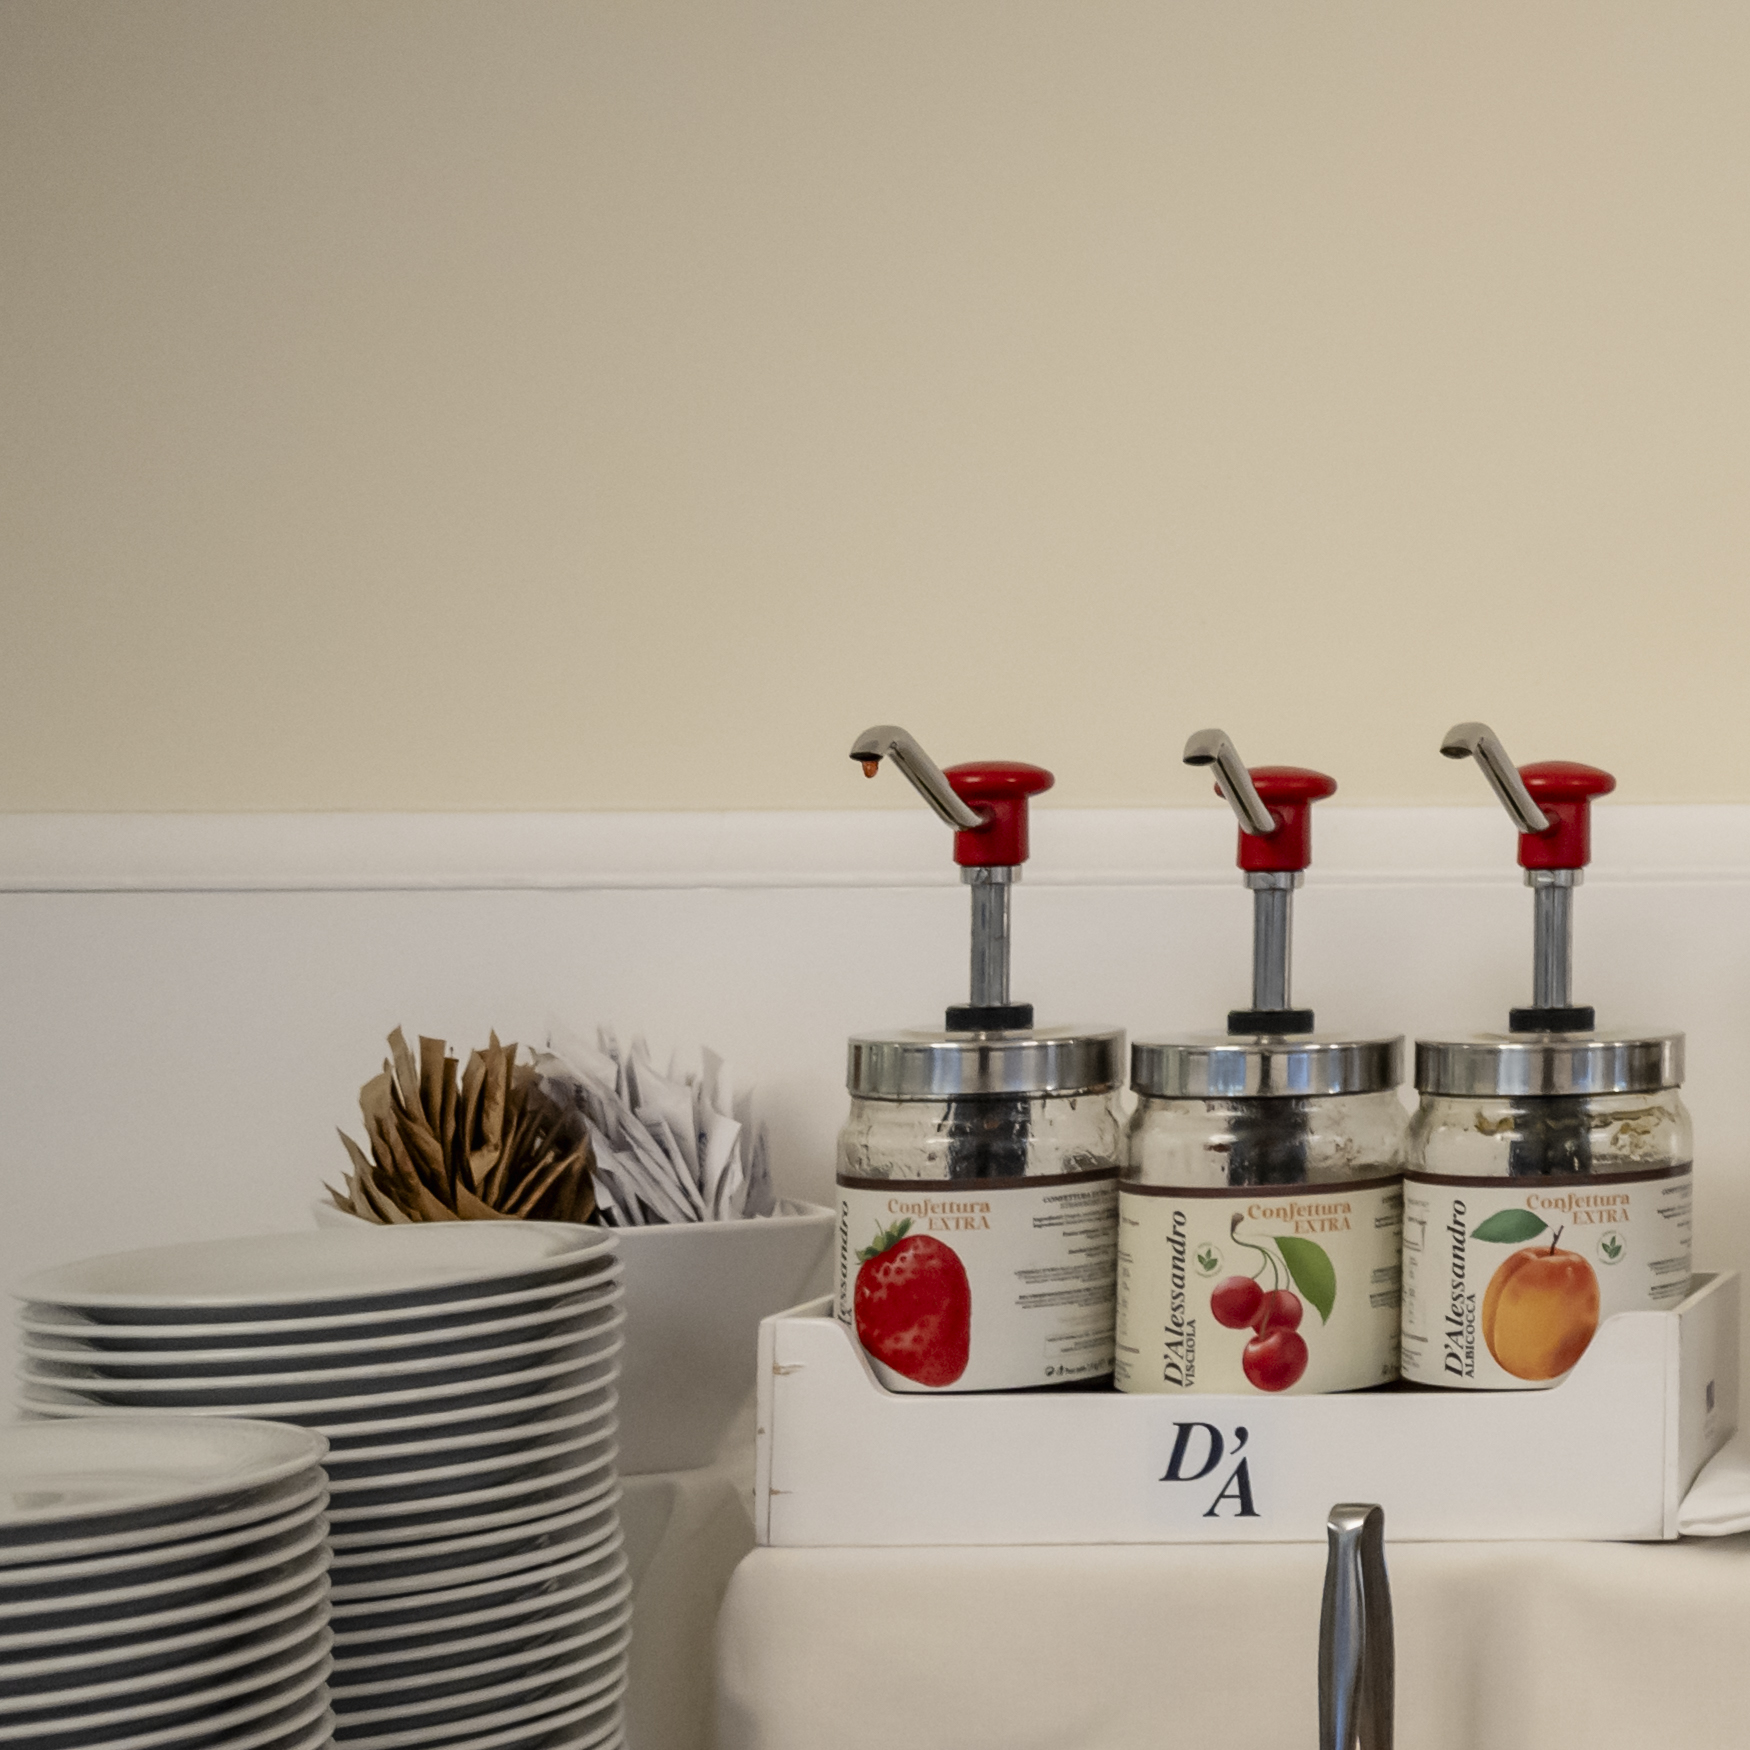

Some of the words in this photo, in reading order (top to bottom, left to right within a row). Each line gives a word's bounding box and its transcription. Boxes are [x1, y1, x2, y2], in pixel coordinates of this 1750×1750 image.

[888, 1198, 991, 1218] Confettura
[1247, 1201, 1353, 1223] Confettura
[1526, 1192, 1631, 1214] Confettura
[928, 1215, 991, 1231] EXTRA
[1294, 1216, 1353, 1235] EXTRA
[1572, 1207, 1631, 1225] EXTRA
[1163, 1210, 1187, 1388] D'Alessandro
[1443, 1199, 1468, 1378] D'Alessandro
[1464, 1293, 1476, 1379] ALBICOCCA
[1185, 1318, 1196, 1388] VISCIOLA
